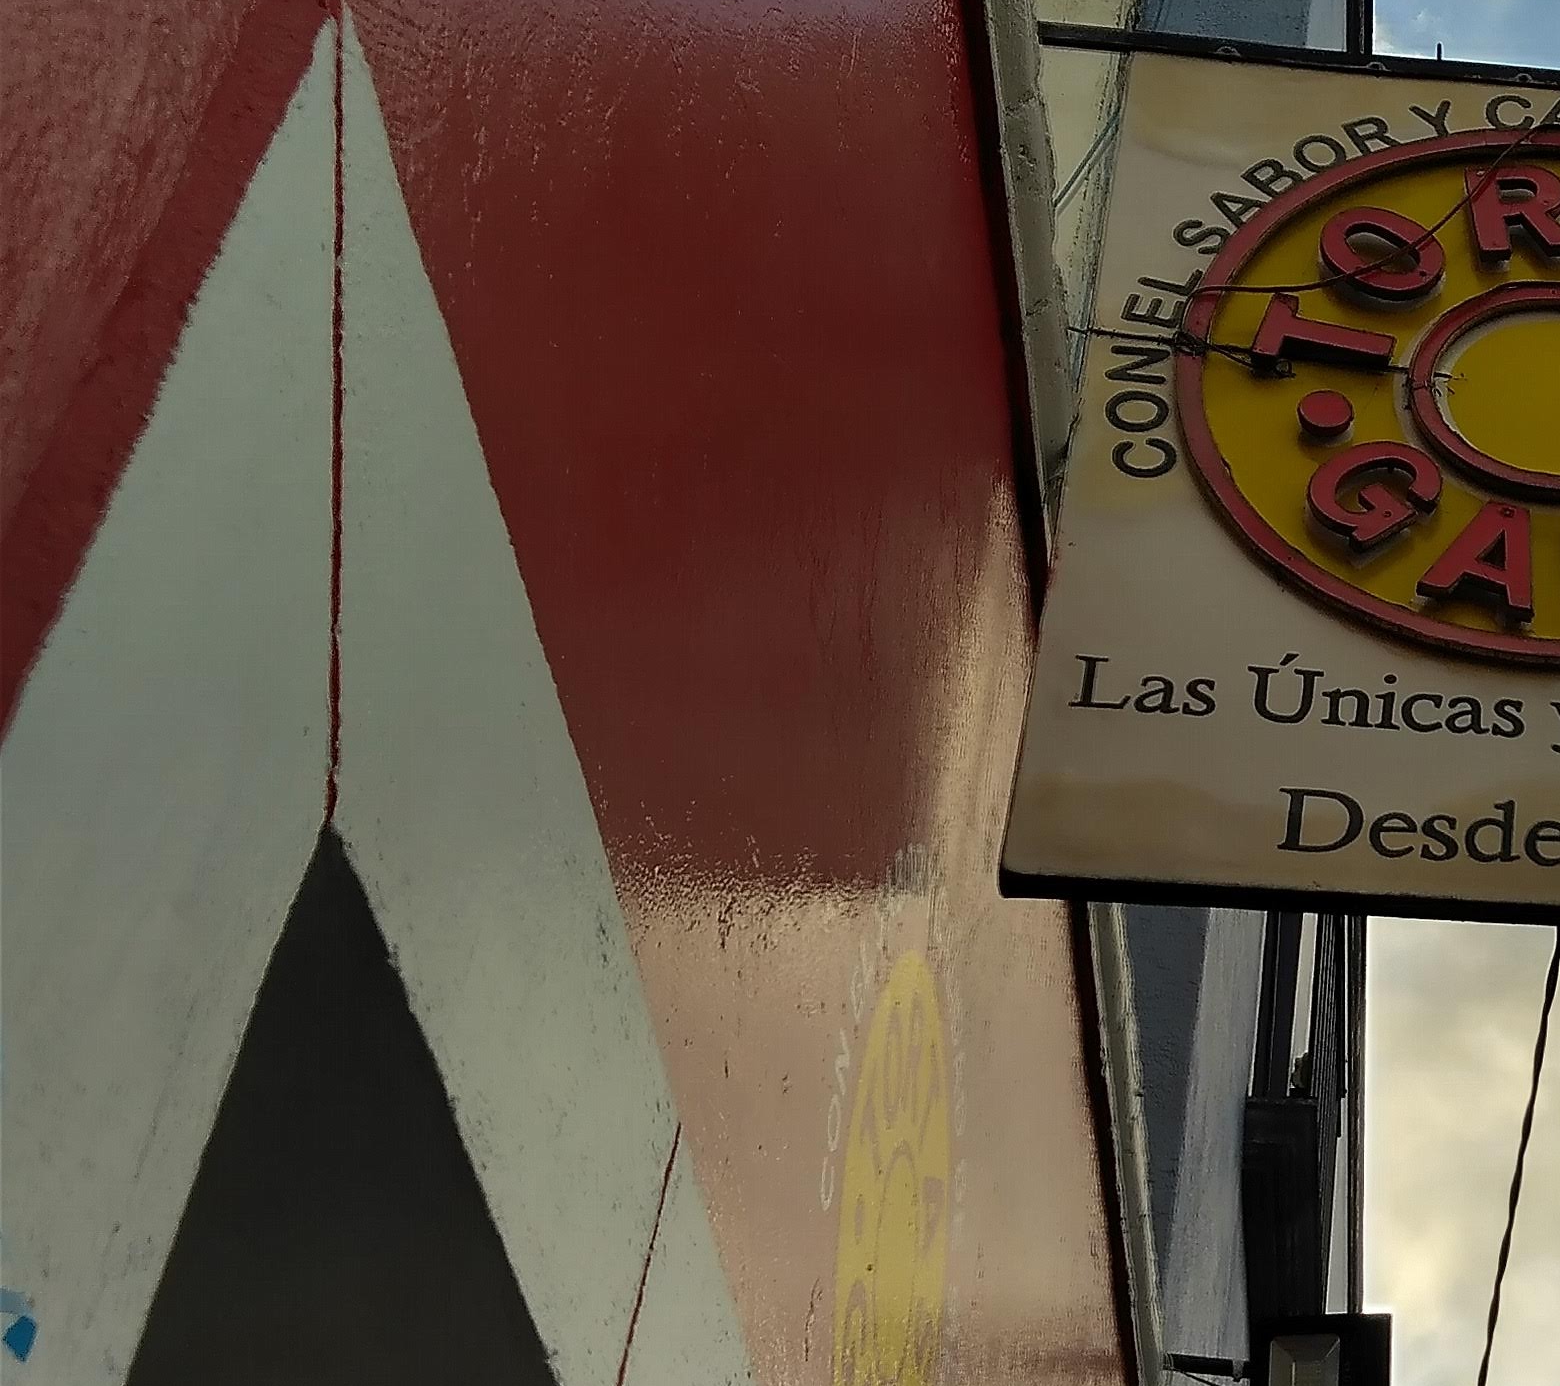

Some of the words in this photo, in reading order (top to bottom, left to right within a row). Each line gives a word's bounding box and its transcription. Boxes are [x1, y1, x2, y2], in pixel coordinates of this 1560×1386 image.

[1408, 99, 1452, 138] Y
[1173, 116, 1402, 255] SABOR
[1120, 269, 1204, 329] EL
[1104, 344, 1178, 480] CON
[1068, 653, 1217, 717] Las
[1247, 652, 1526, 738] Únicas
